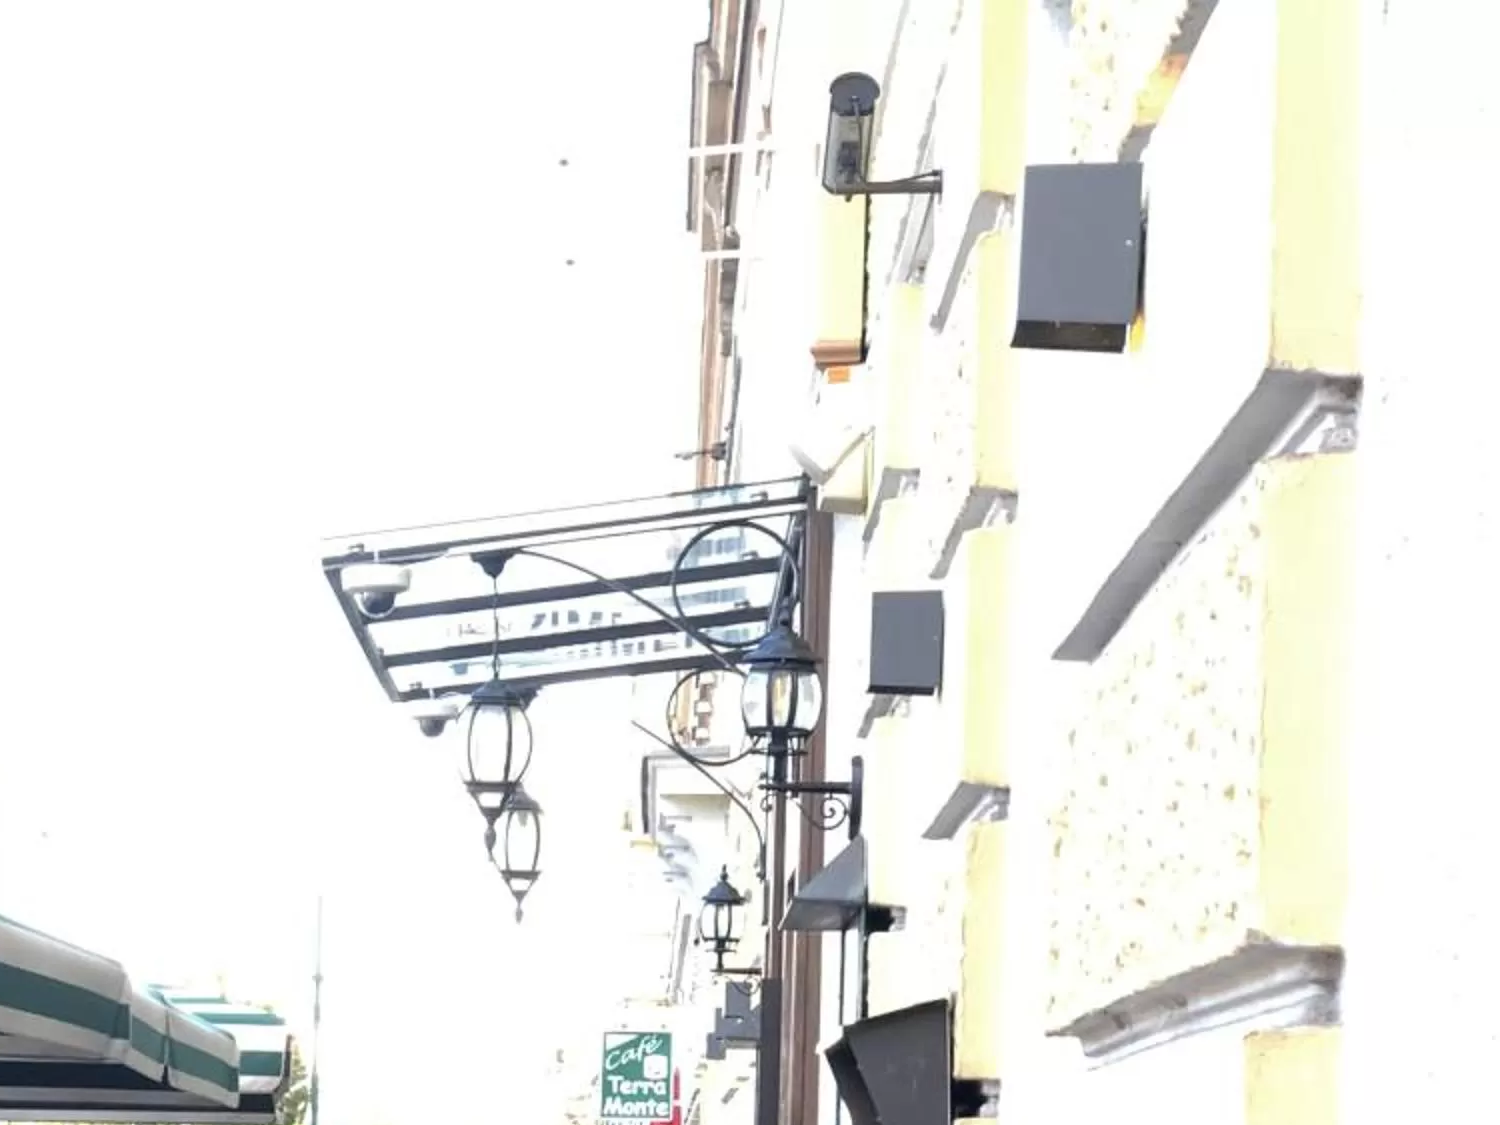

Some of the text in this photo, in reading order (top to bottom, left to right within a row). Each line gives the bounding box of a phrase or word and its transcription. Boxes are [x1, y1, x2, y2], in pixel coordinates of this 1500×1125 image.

[605, 1034, 663, 1071] Café
[607, 1075, 667, 1095] Terra
[604, 1097, 669, 1116] Monte
